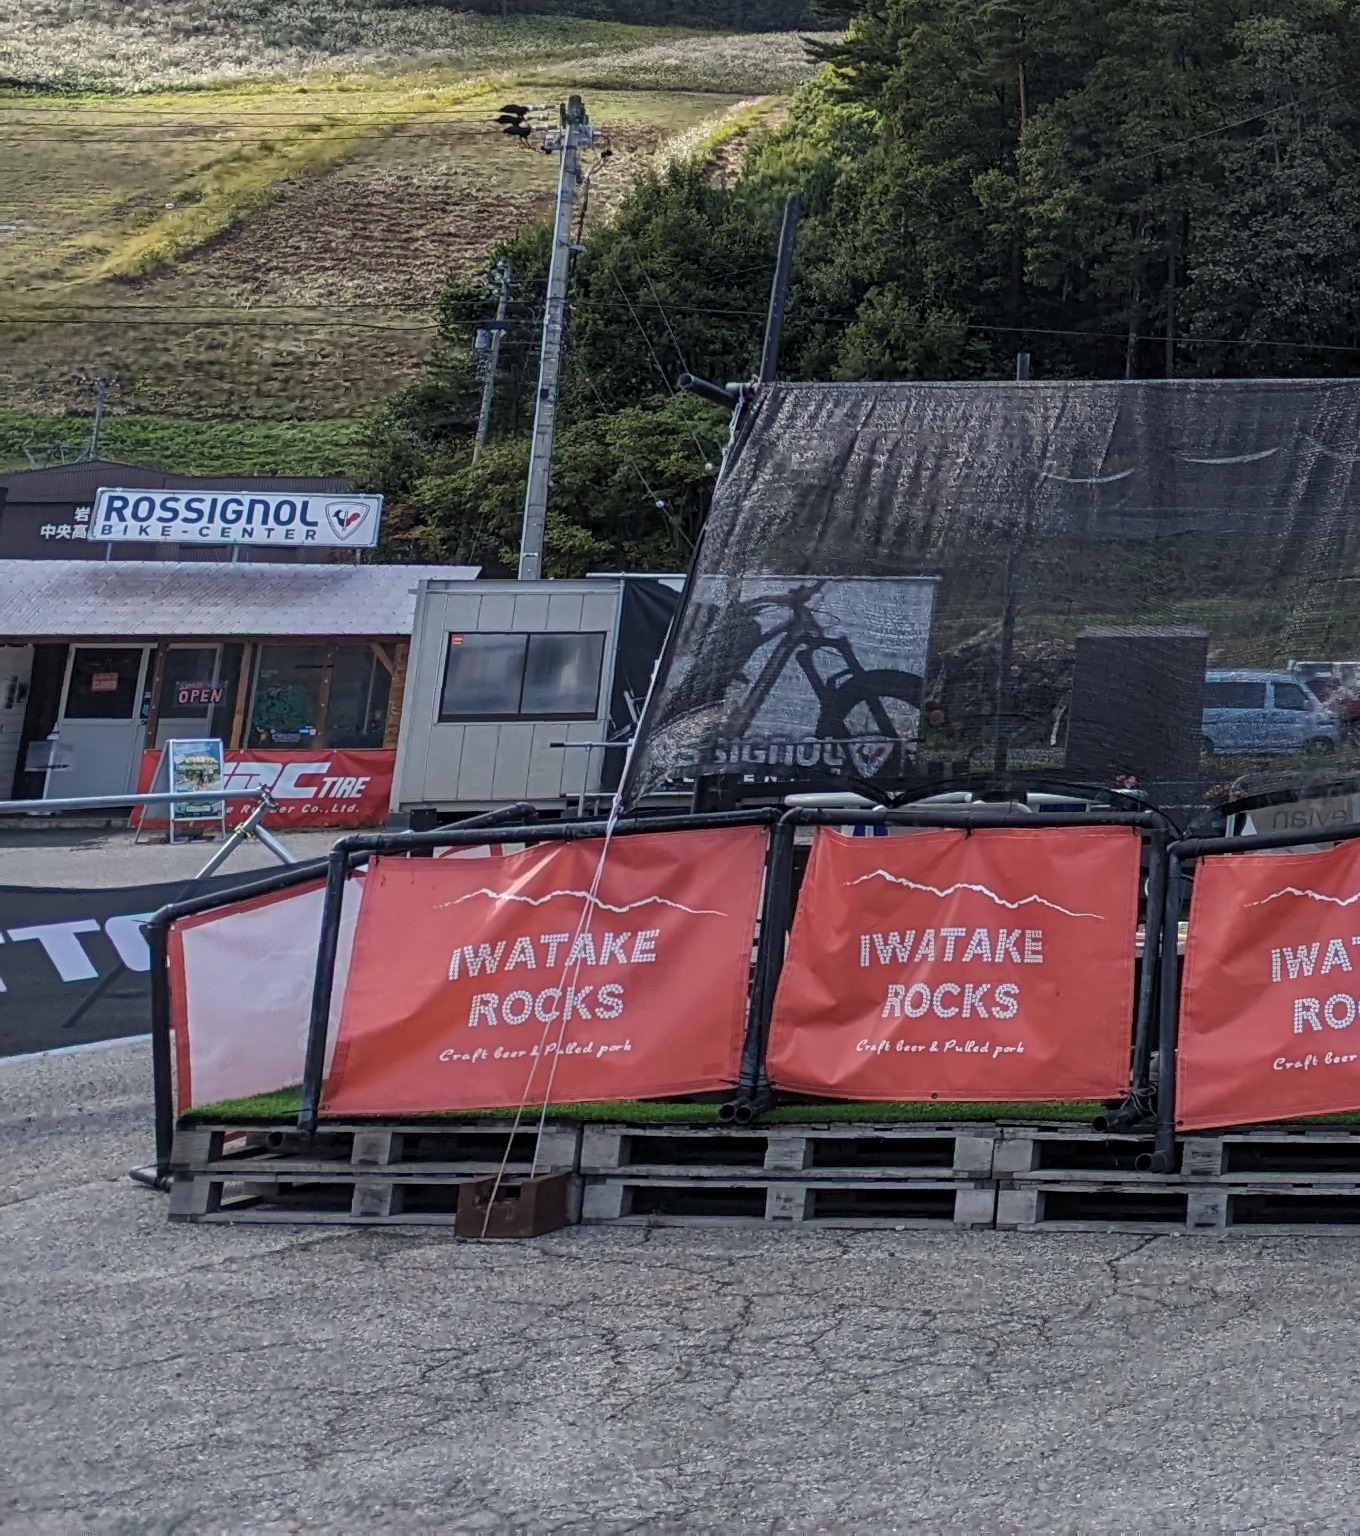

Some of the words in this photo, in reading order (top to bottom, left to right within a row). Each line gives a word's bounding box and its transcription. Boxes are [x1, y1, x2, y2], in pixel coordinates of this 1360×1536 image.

[103, 495, 318, 527] ROSSIGNOL
[178, 688, 223, 704] OPEN
[318, 776, 371, 799] TIRE
[448, 928, 660, 980] IWATAKE
[860, 927, 1044, 967] IWATAKE
[467, 983, 624, 1027] ROCKS
[882, 983, 1019, 1019] ROCKS
[439, 1048, 488, 1063] Craft
[544, 1042, 593, 1057] Pulled
[596, 1040, 632, 1057] pork
[856, 1039, 890, 1054] Craft
[896, 1039, 925, 1052] beer
[929, 1040, 939, 1052] &
[943, 1039, 988, 1053] Pulled
[992, 1042, 1025, 1058] pork
[1273, 1054, 1318, 1071] Craft
[1325, 1052, 1357, 1064] beer
